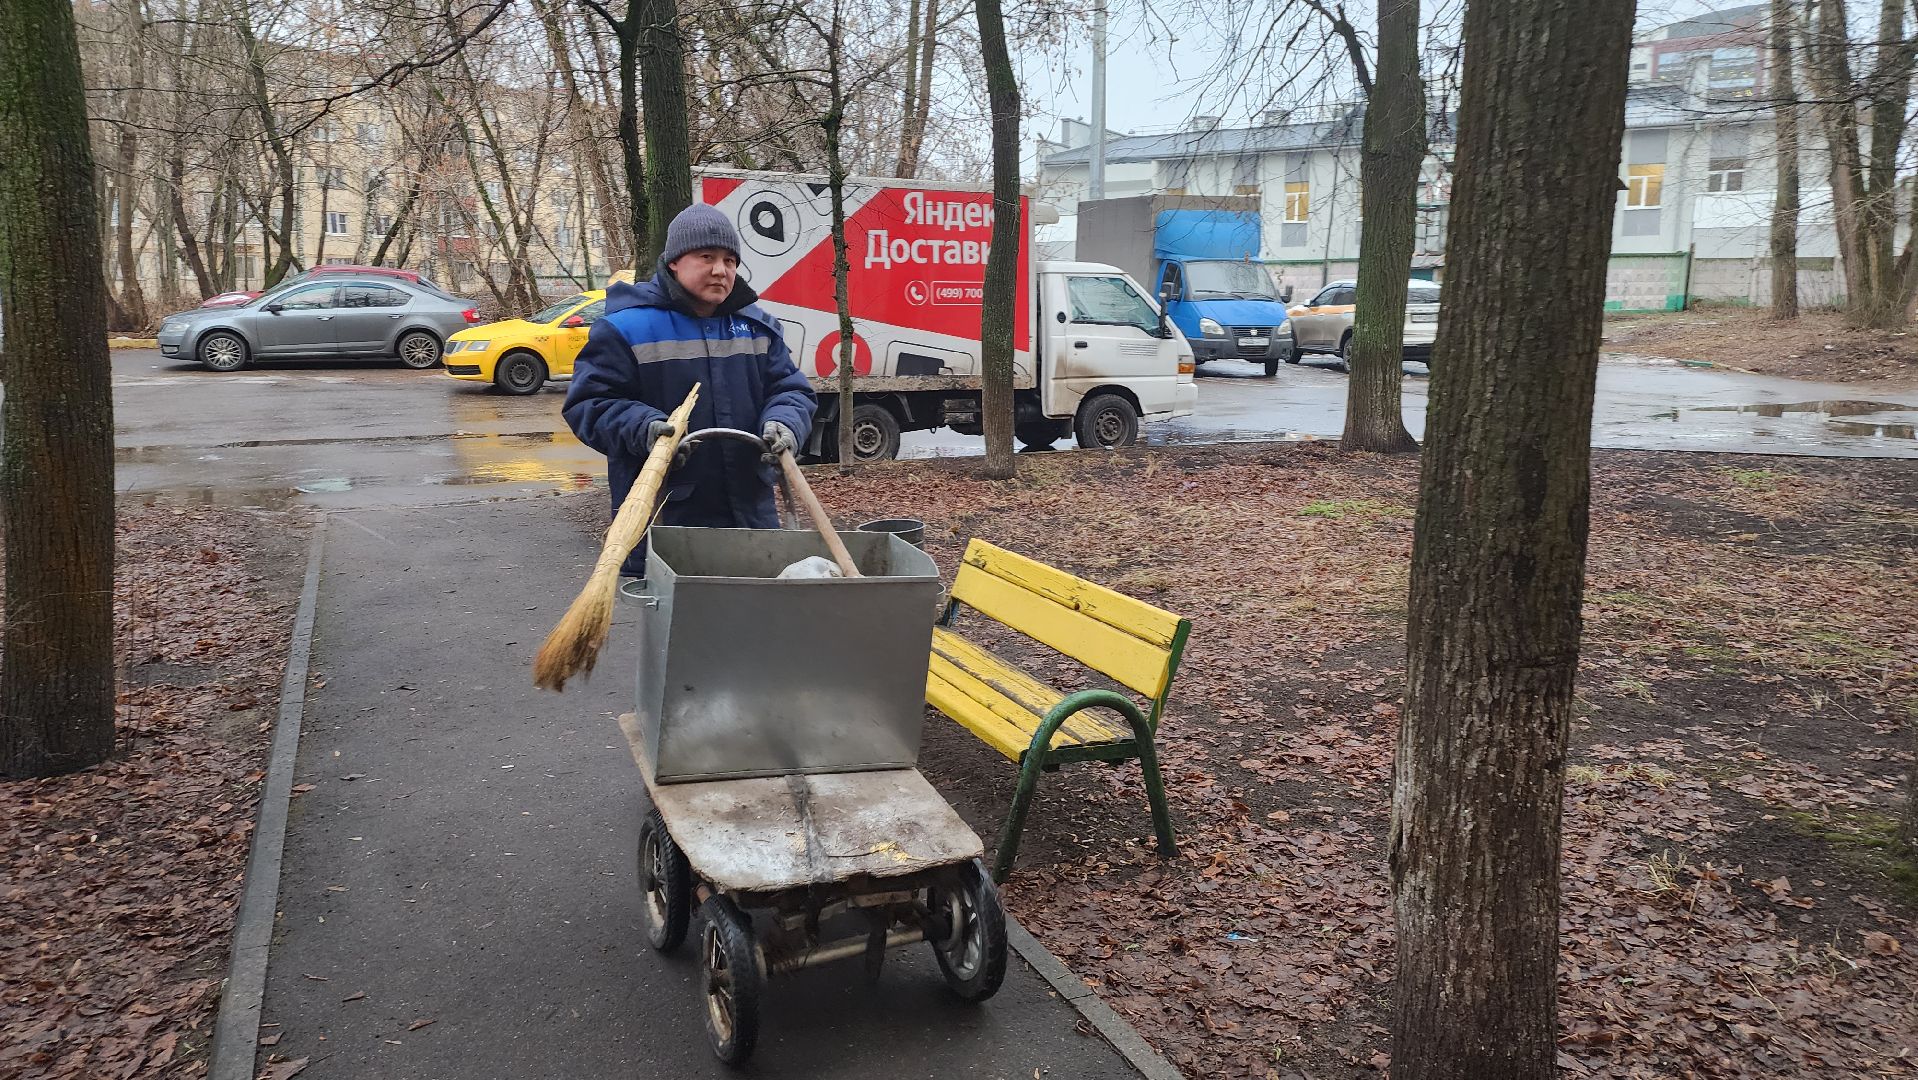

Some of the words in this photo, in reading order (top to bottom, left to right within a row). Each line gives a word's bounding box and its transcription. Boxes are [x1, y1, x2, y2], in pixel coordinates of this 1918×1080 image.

[903, 191, 995, 231] Яндек
[864, 229, 991, 270] Доставк
[936, 287, 963, 300] (499)
